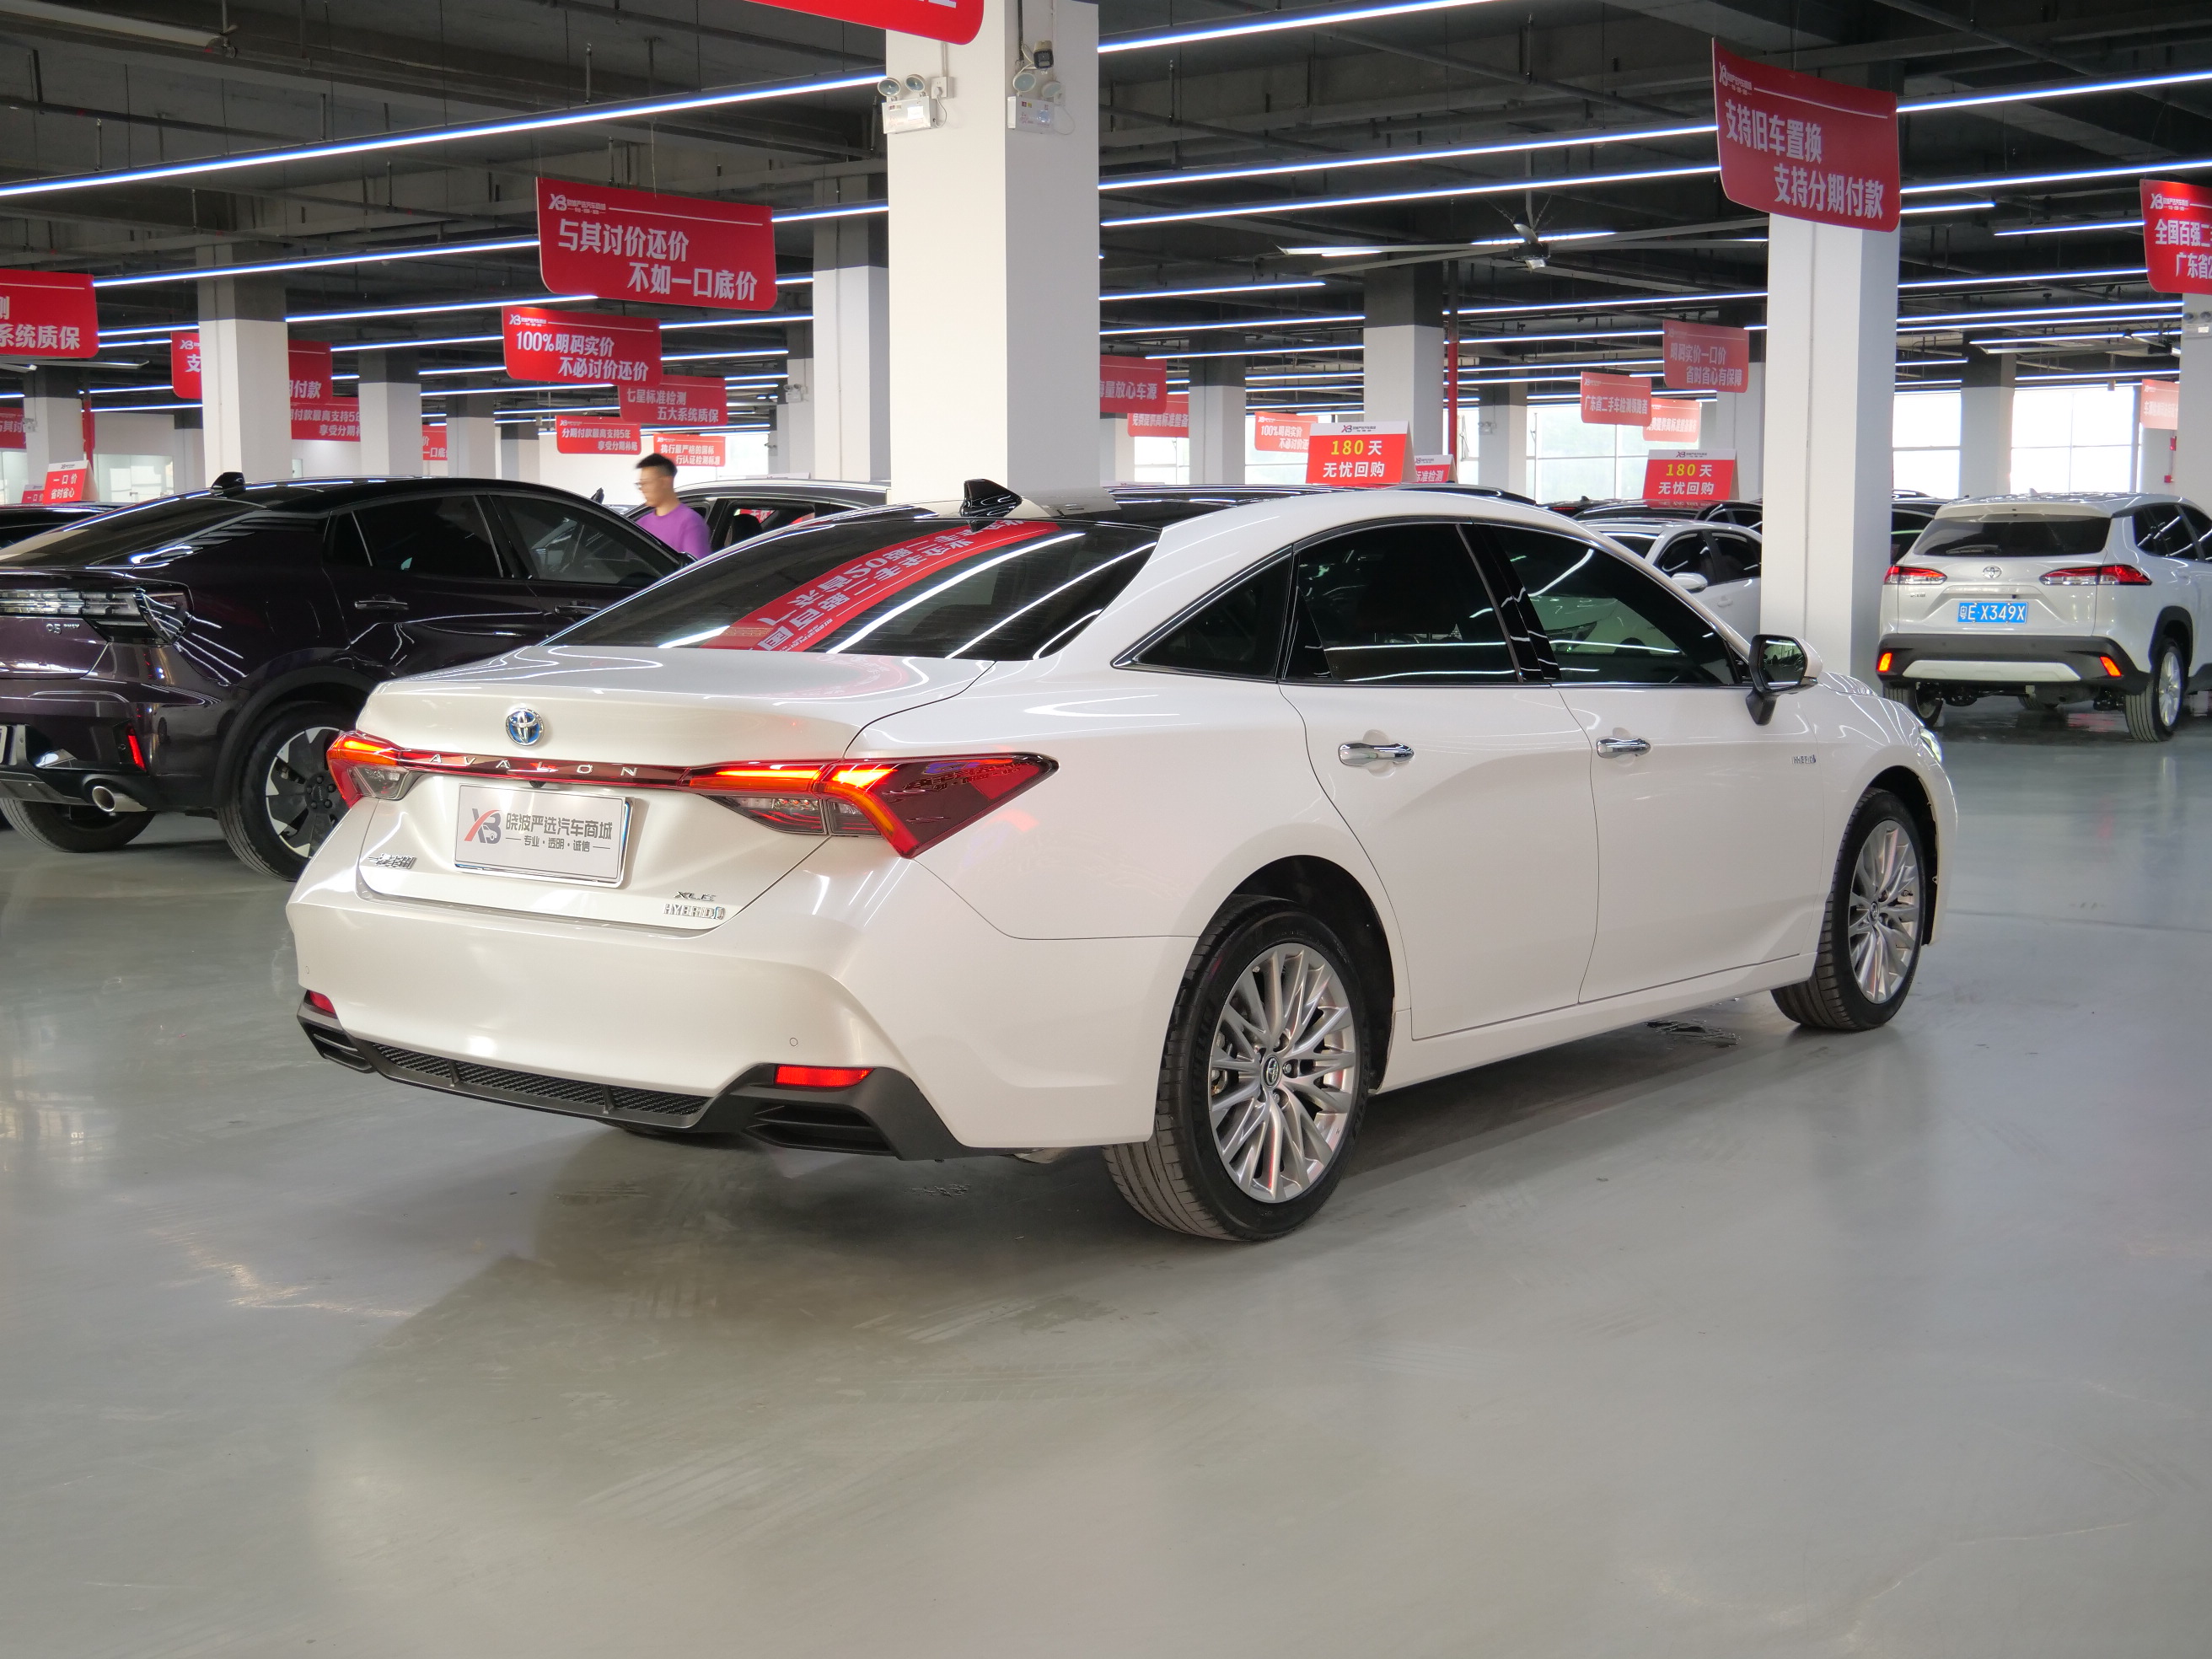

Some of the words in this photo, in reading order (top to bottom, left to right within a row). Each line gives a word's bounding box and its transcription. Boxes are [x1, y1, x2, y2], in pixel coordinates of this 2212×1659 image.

[1725, 99, 1822, 164] 支持旧车置换
[1774, 163, 1883, 219] 支持分期付款
[558, 218, 689, 262] 与其讨价还价
[2155, 218, 2212, 248] 全国百强二
[627, 261, 758, 302] 不如一口底价
[0, 323, 81, 351] 系统质保
[516, 330, 615, 357] 100%明码实价
[1670, 342, 1726, 365] 明码实价一口价
[558, 357, 649, 382] 不必讨价还价
[1686, 365, 1742, 387] 省时省心有保障
[626, 388, 687, 406] 七星标准检测
[657, 406, 719, 423] 五大系统质保
[422, 447, 448, 459] 一口底
[1322, 461, 1385, 478] 无忧回购
[1657, 481, 1715, 496] 无忧回购
[428, 753, 638, 776] AVALON
[506, 813, 613, 840] 晓波严选汽车商城
